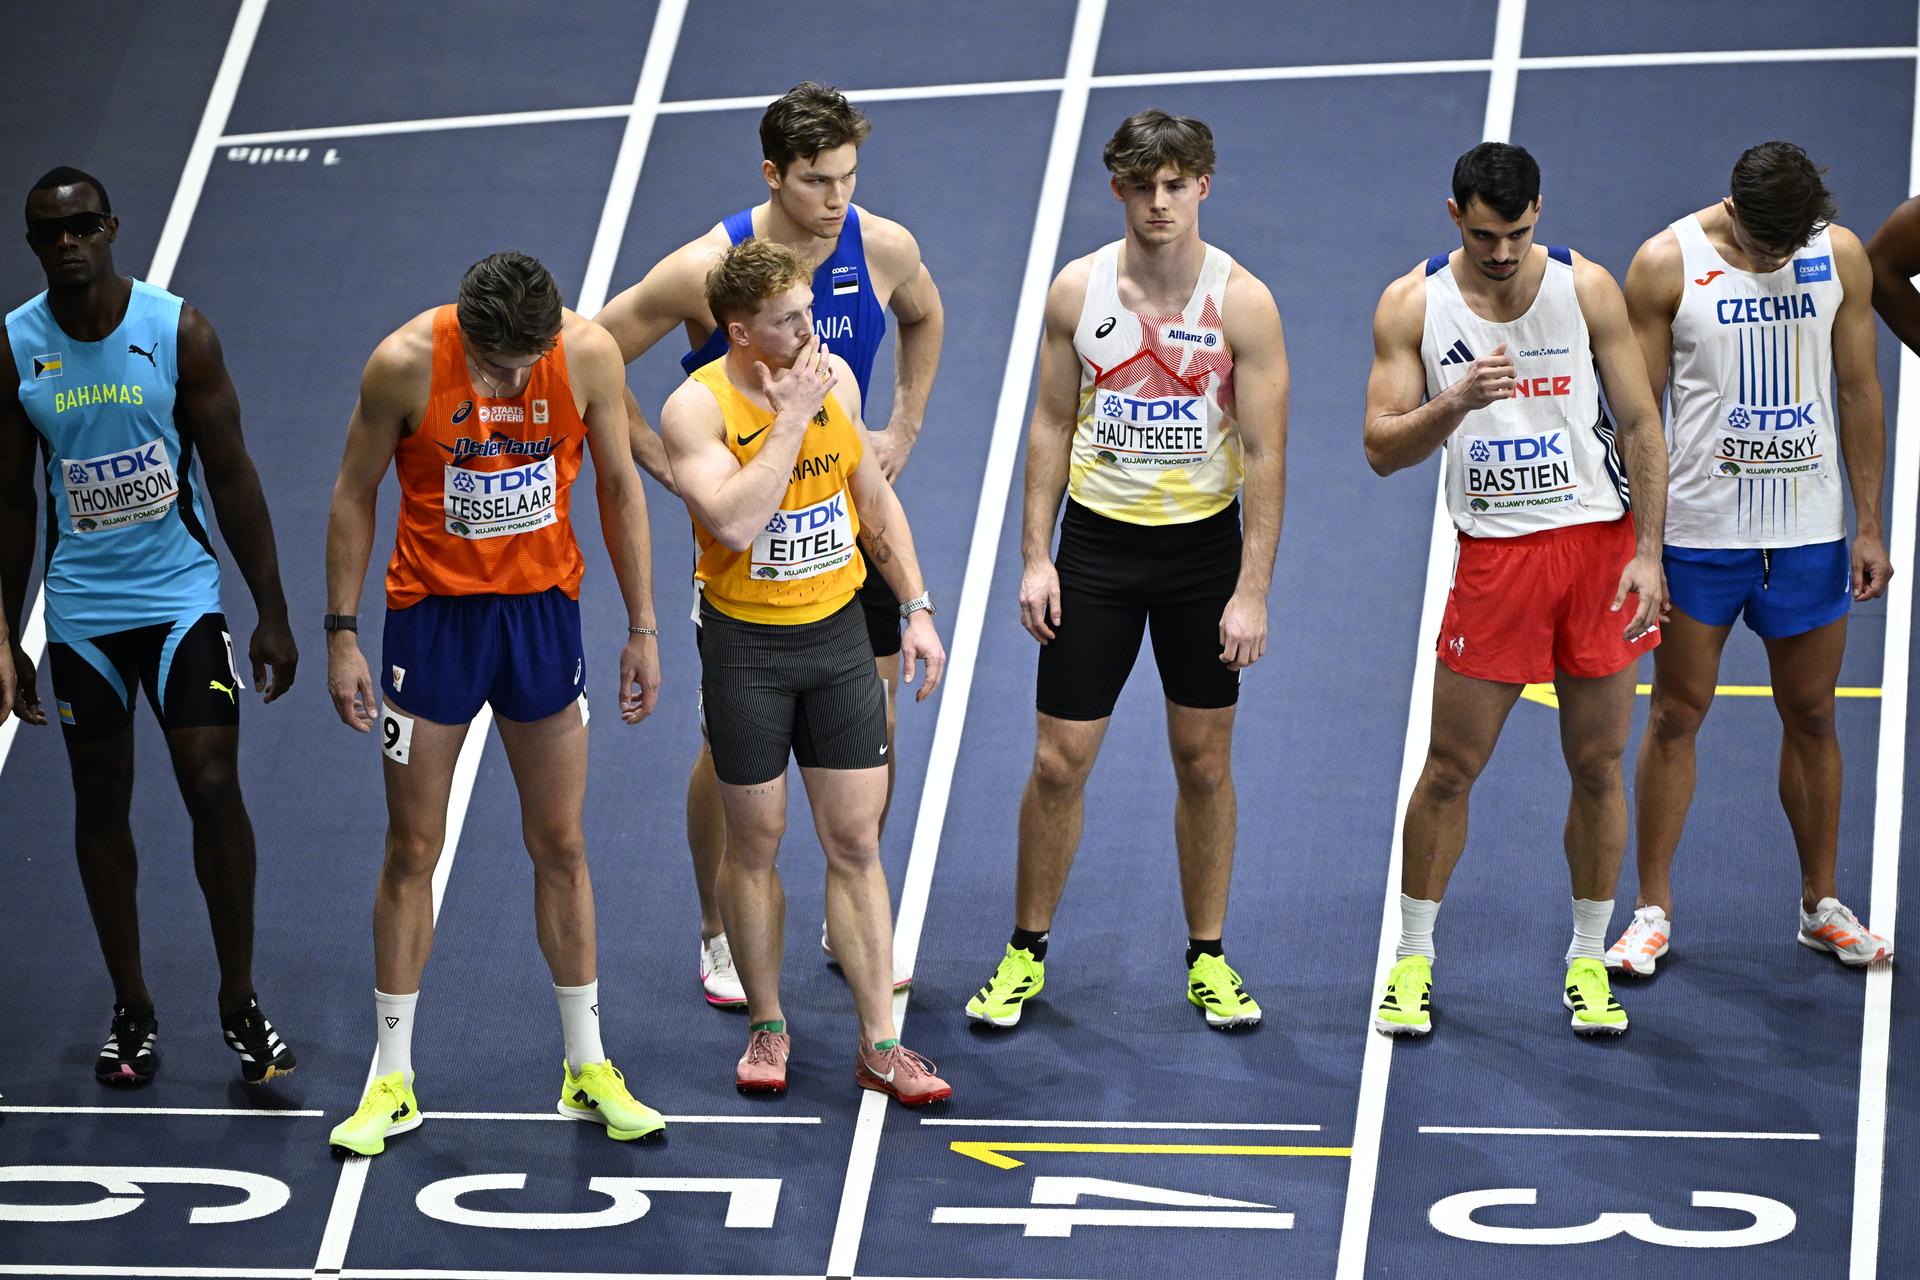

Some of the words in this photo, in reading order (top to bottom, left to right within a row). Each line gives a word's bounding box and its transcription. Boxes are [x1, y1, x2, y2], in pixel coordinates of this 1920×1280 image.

[1716, 292, 1817, 324] CZECHIA
[1168, 329, 1203, 343] Allianz
[1547, 347, 1570, 355] Mutuel
[55, 384, 143, 413] BAHAMAS
[1511, 375, 1571, 399] NCE
[491, 406, 524, 414] STAATS
[1123, 398, 1198, 421] TDK
[1751, 403, 1816, 431] TDK
[1096, 421, 1203, 450] HAUTTEKEETE
[1488, 432, 1564, 462] TDK
[1722, 429, 1817, 460] STRÁSKÝ
[84, 444, 162, 481] TDK
[1121, 456, 1153, 466] KUJAWY
[1154, 457, 1191, 466] POMORZE
[1746, 467, 1776, 475] KUJAWY
[1777, 464, 1810, 474] POMORZE
[70, 469, 172, 512] THOMPSON
[475, 463, 548, 494] TDK
[1469, 460, 1569, 492] BASTIEN
[101, 514, 132, 527] KUJAWY
[133, 504, 169, 520] POMORZE
[449, 485, 551, 520] TESSELAAR
[786, 495, 844, 534] TDK
[1494, 499, 1525, 509] KUJAWY
[1526, 495, 1563, 506] POMORZE
[1563, 493, 1574, 501] 26
[475, 525, 506, 535] KUJAWY
[508, 517, 543, 531] POMORZE
[769, 529, 844, 561] EITEL
[784, 565, 813, 577] KUJAWY
[813, 556, 844, 570] POMORZE
[0, 1166, 290, 1224] 6
[415, 1173, 782, 1230] 5
[931, 1176, 1295, 1237] 4
[1429, 1188, 1796, 1248] 3
